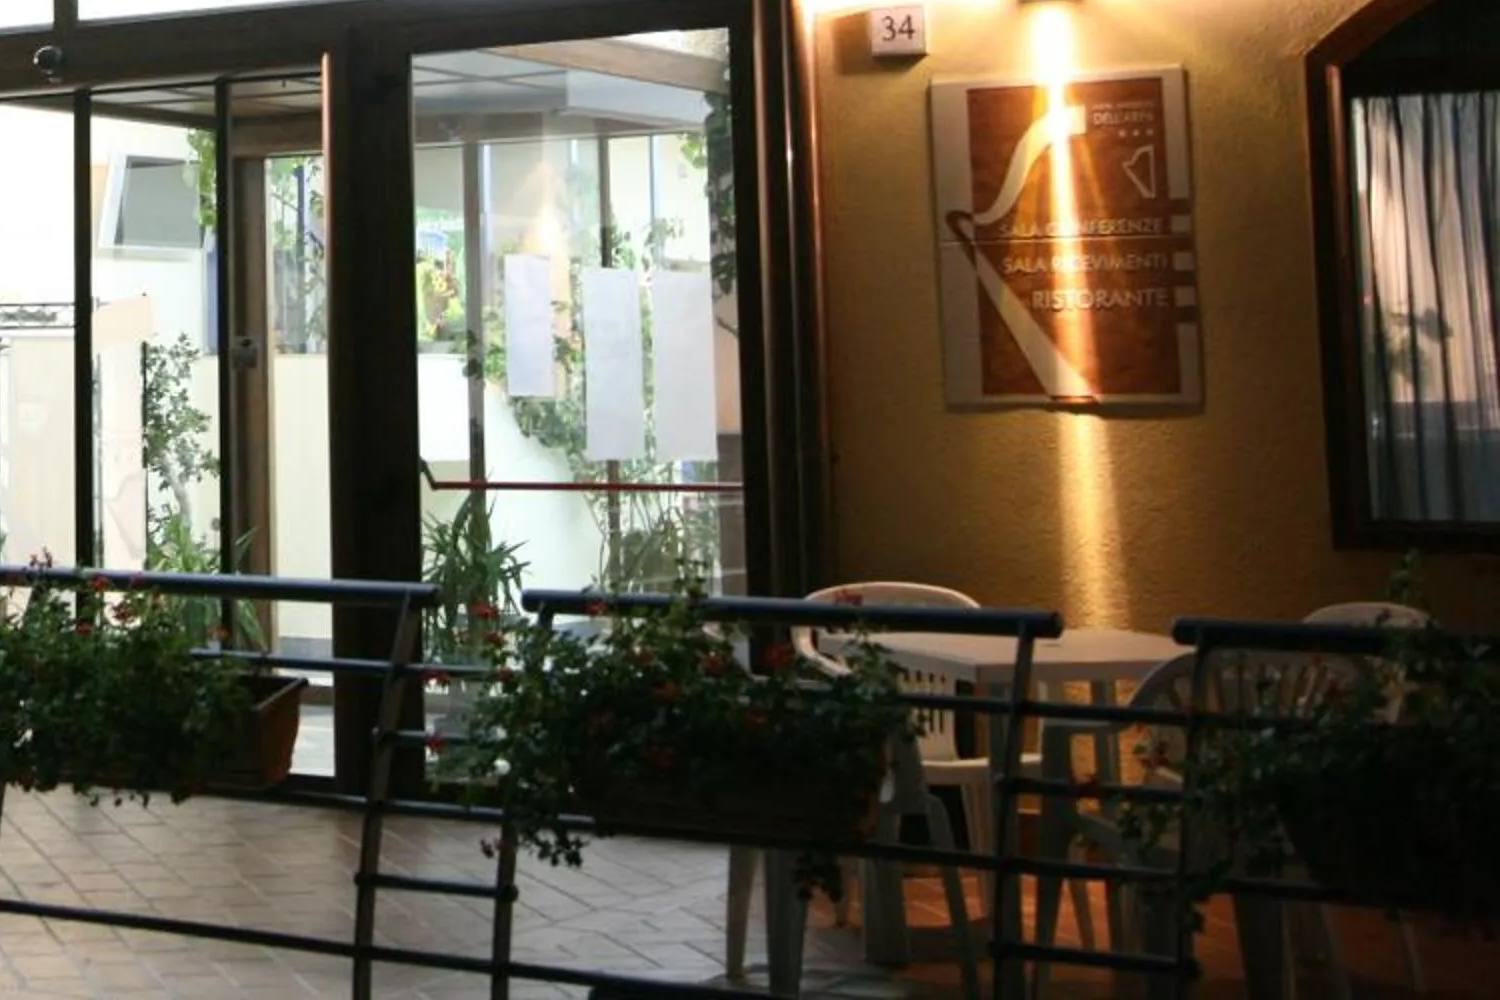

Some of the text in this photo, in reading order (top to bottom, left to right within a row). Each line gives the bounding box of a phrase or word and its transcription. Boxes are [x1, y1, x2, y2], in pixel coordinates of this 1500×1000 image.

[881, 14, 915, 41] 34
[1046, 215, 1164, 236] CNFERENZE
[1003, 251, 1168, 274] SALA RCEVIMENTI
[1032, 287, 1169, 311] RISTORANTE
